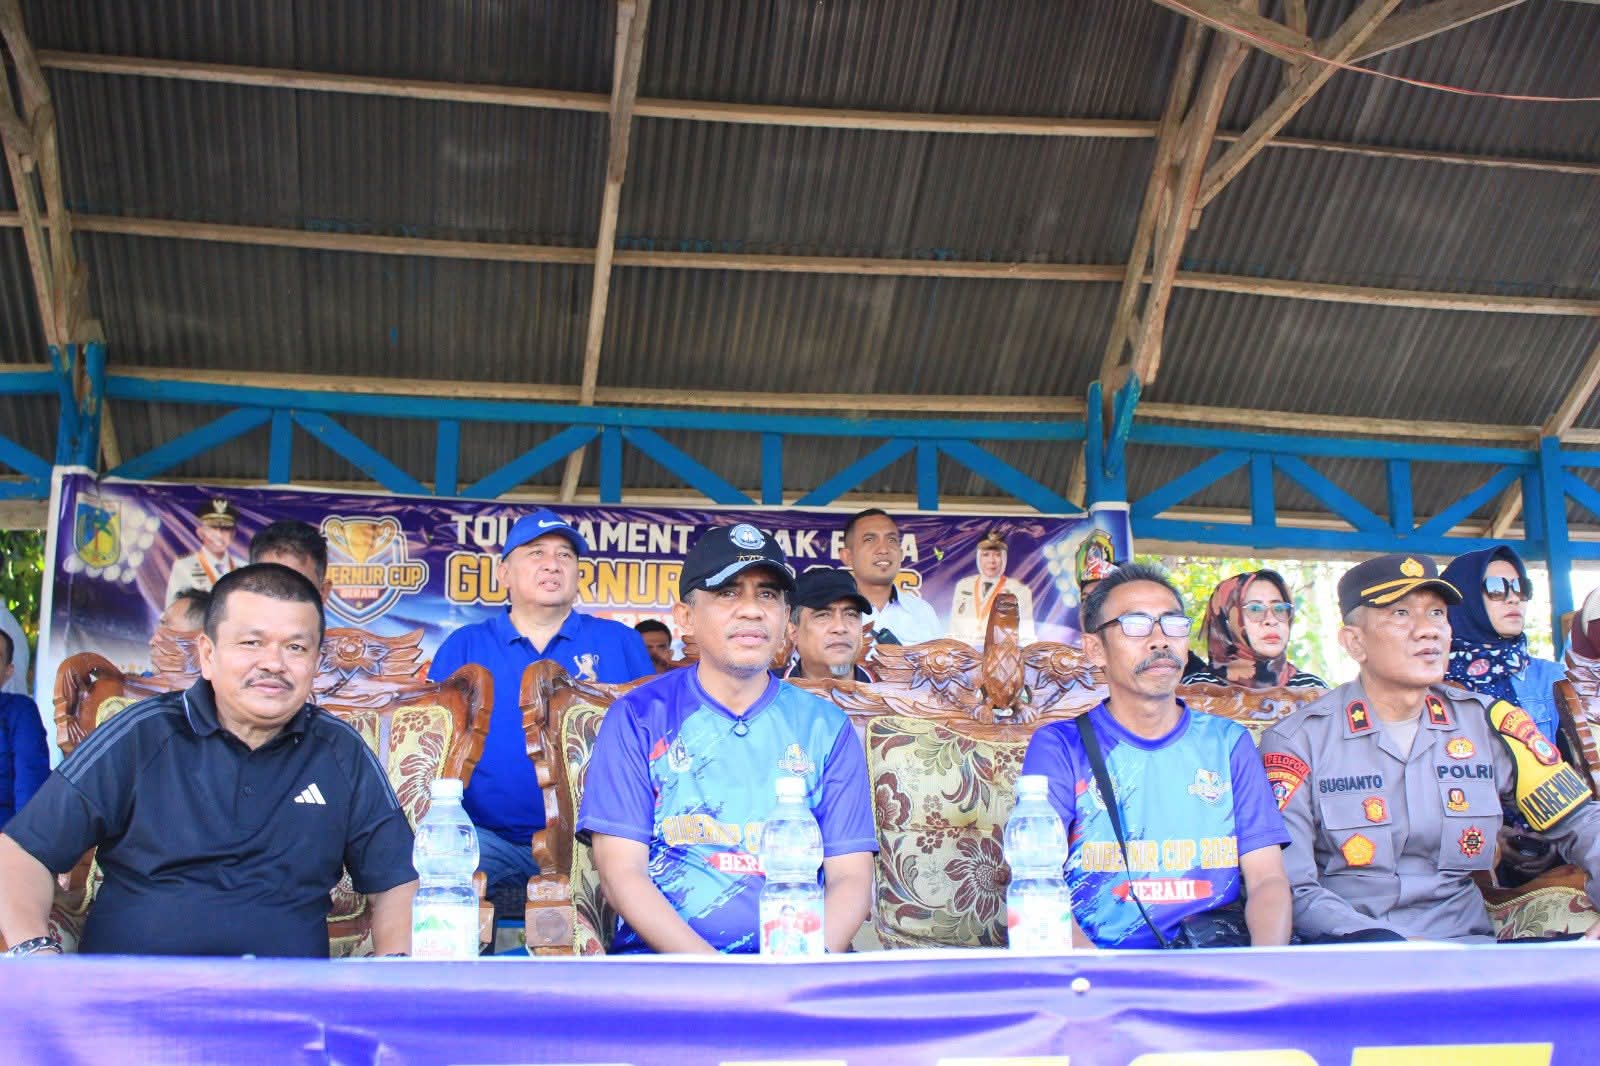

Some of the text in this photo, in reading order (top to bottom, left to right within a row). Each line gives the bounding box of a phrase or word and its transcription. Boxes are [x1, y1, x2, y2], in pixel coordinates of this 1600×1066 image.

[389, 566, 422, 587] CUP
[446, 551, 682, 608] GURNUR
[1437, 764, 1493, 779] POLRI
[1319, 774, 1384, 794] SUGIANTO
[1162, 839, 1196, 871] CUP
